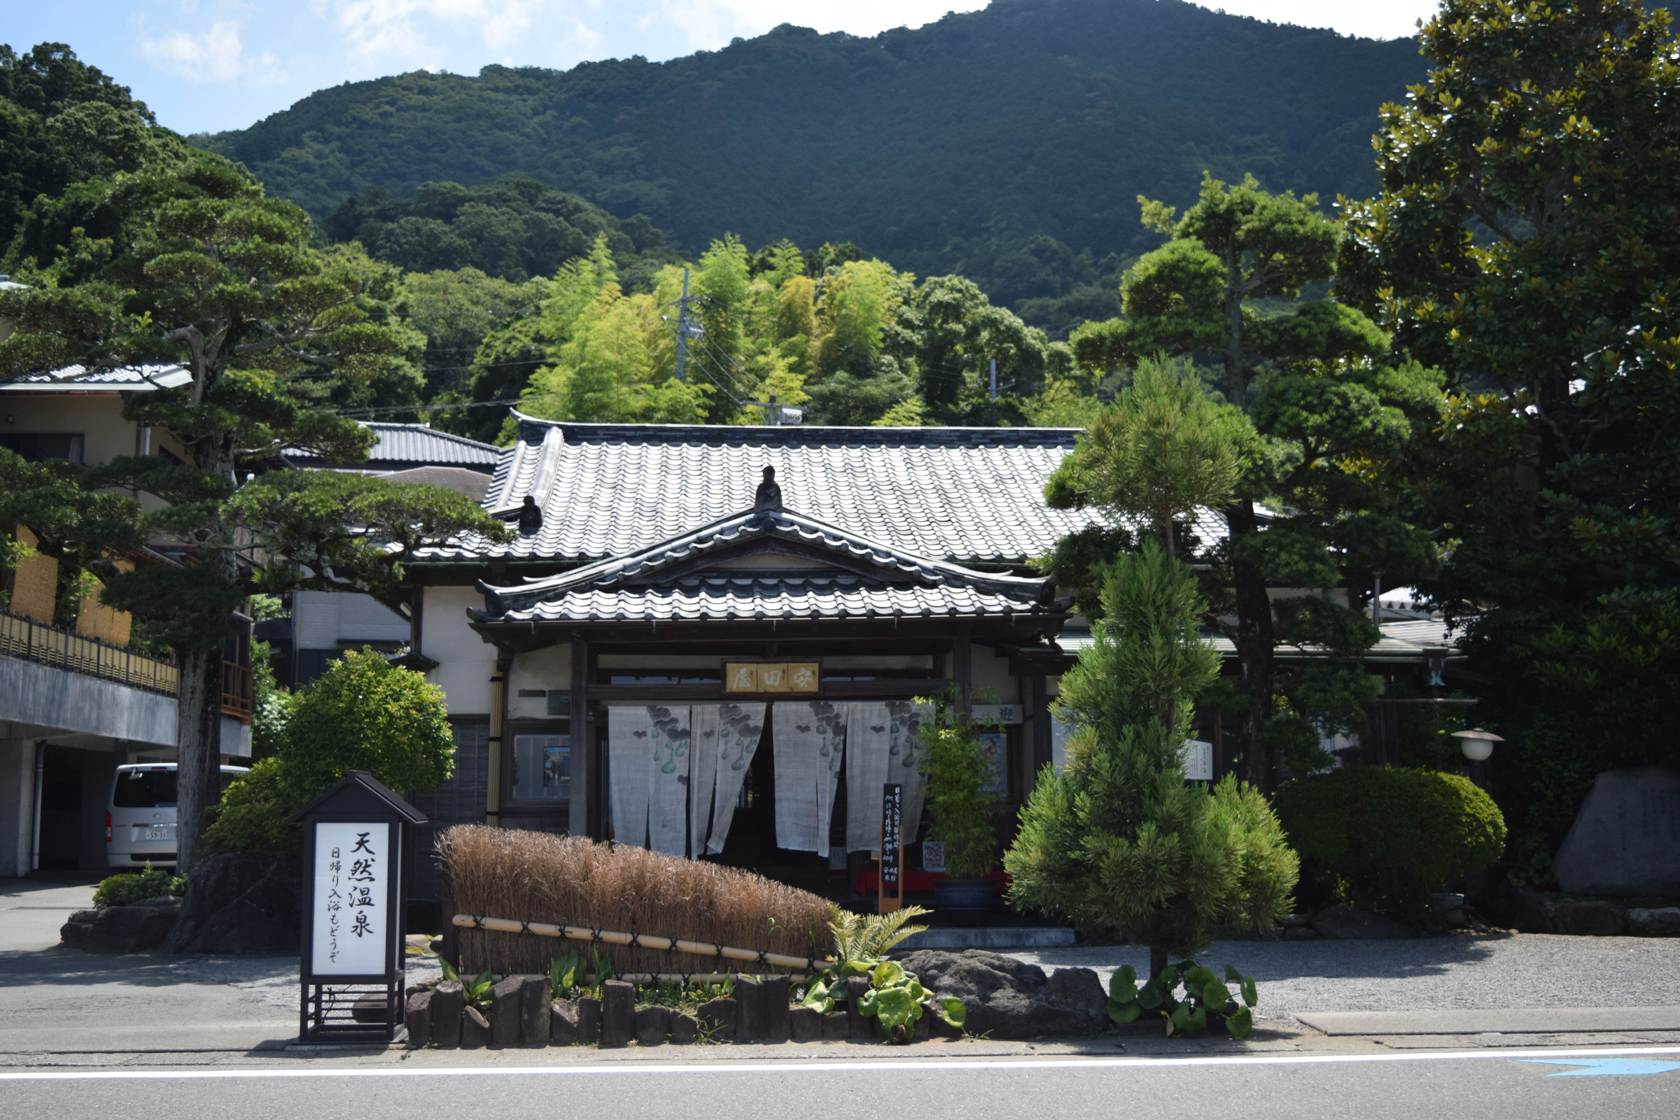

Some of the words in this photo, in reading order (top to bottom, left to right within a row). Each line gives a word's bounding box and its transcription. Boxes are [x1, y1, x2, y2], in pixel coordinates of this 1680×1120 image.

[327, 847, 342, 964] 日帰り入浴もどうぞ
[348, 832, 376, 938] 天然温泉
